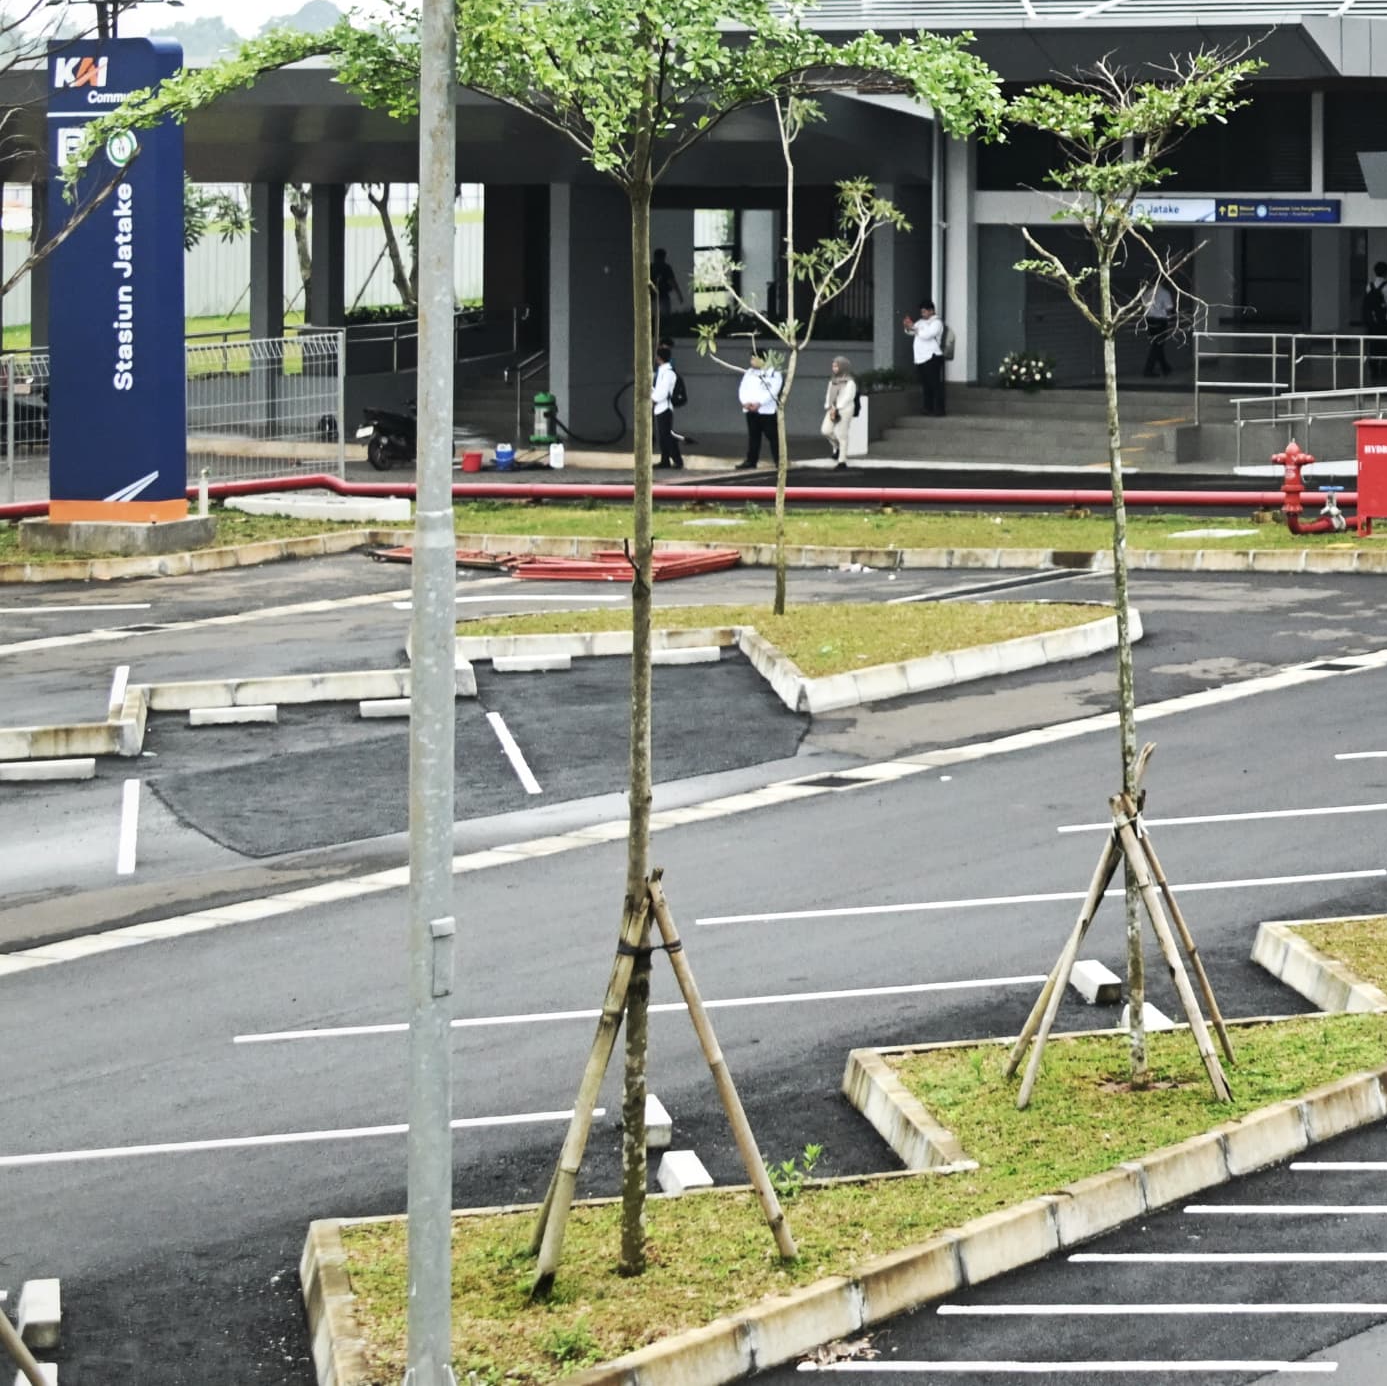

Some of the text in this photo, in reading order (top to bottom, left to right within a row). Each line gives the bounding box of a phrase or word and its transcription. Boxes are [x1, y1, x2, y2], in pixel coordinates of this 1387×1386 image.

[54, 56, 109, 89] KAI
[112, 182, 134, 391] Stasiun Jatake
